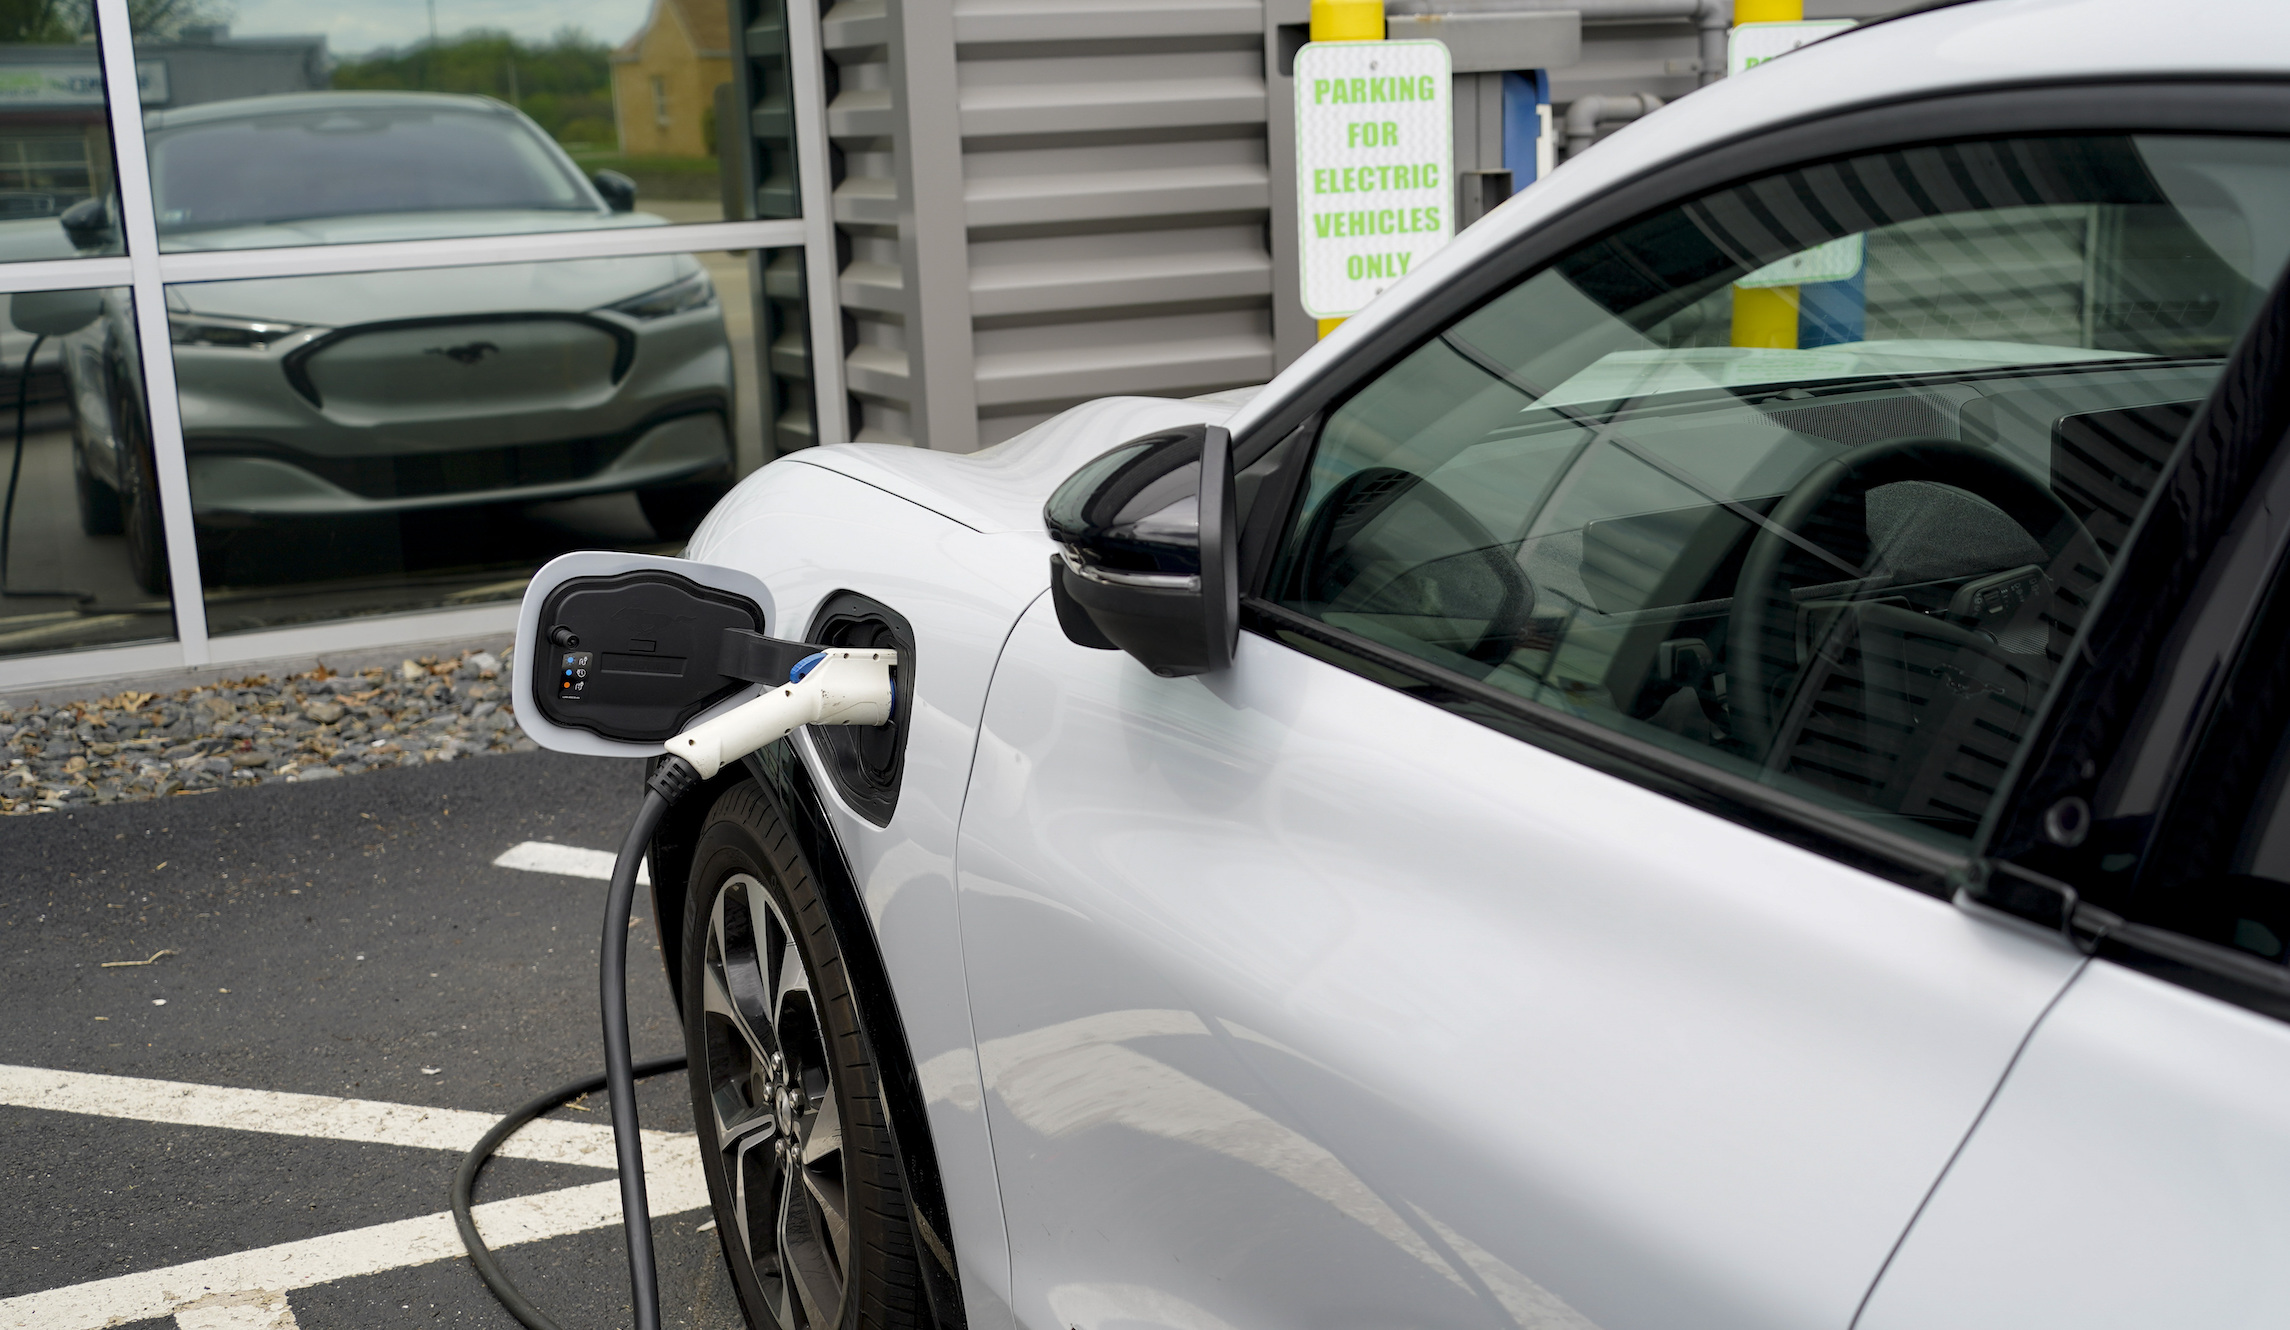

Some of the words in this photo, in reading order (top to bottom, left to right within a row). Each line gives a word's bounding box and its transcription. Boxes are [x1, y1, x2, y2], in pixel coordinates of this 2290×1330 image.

[1313, 75, 1435, 104] PARKING
[1347, 121, 1399, 148] FOR
[1313, 163, 1439, 194] ELECTRIC
[1313, 207, 1441, 238] VEHICLES
[1346, 252, 1412, 281] ONLY
